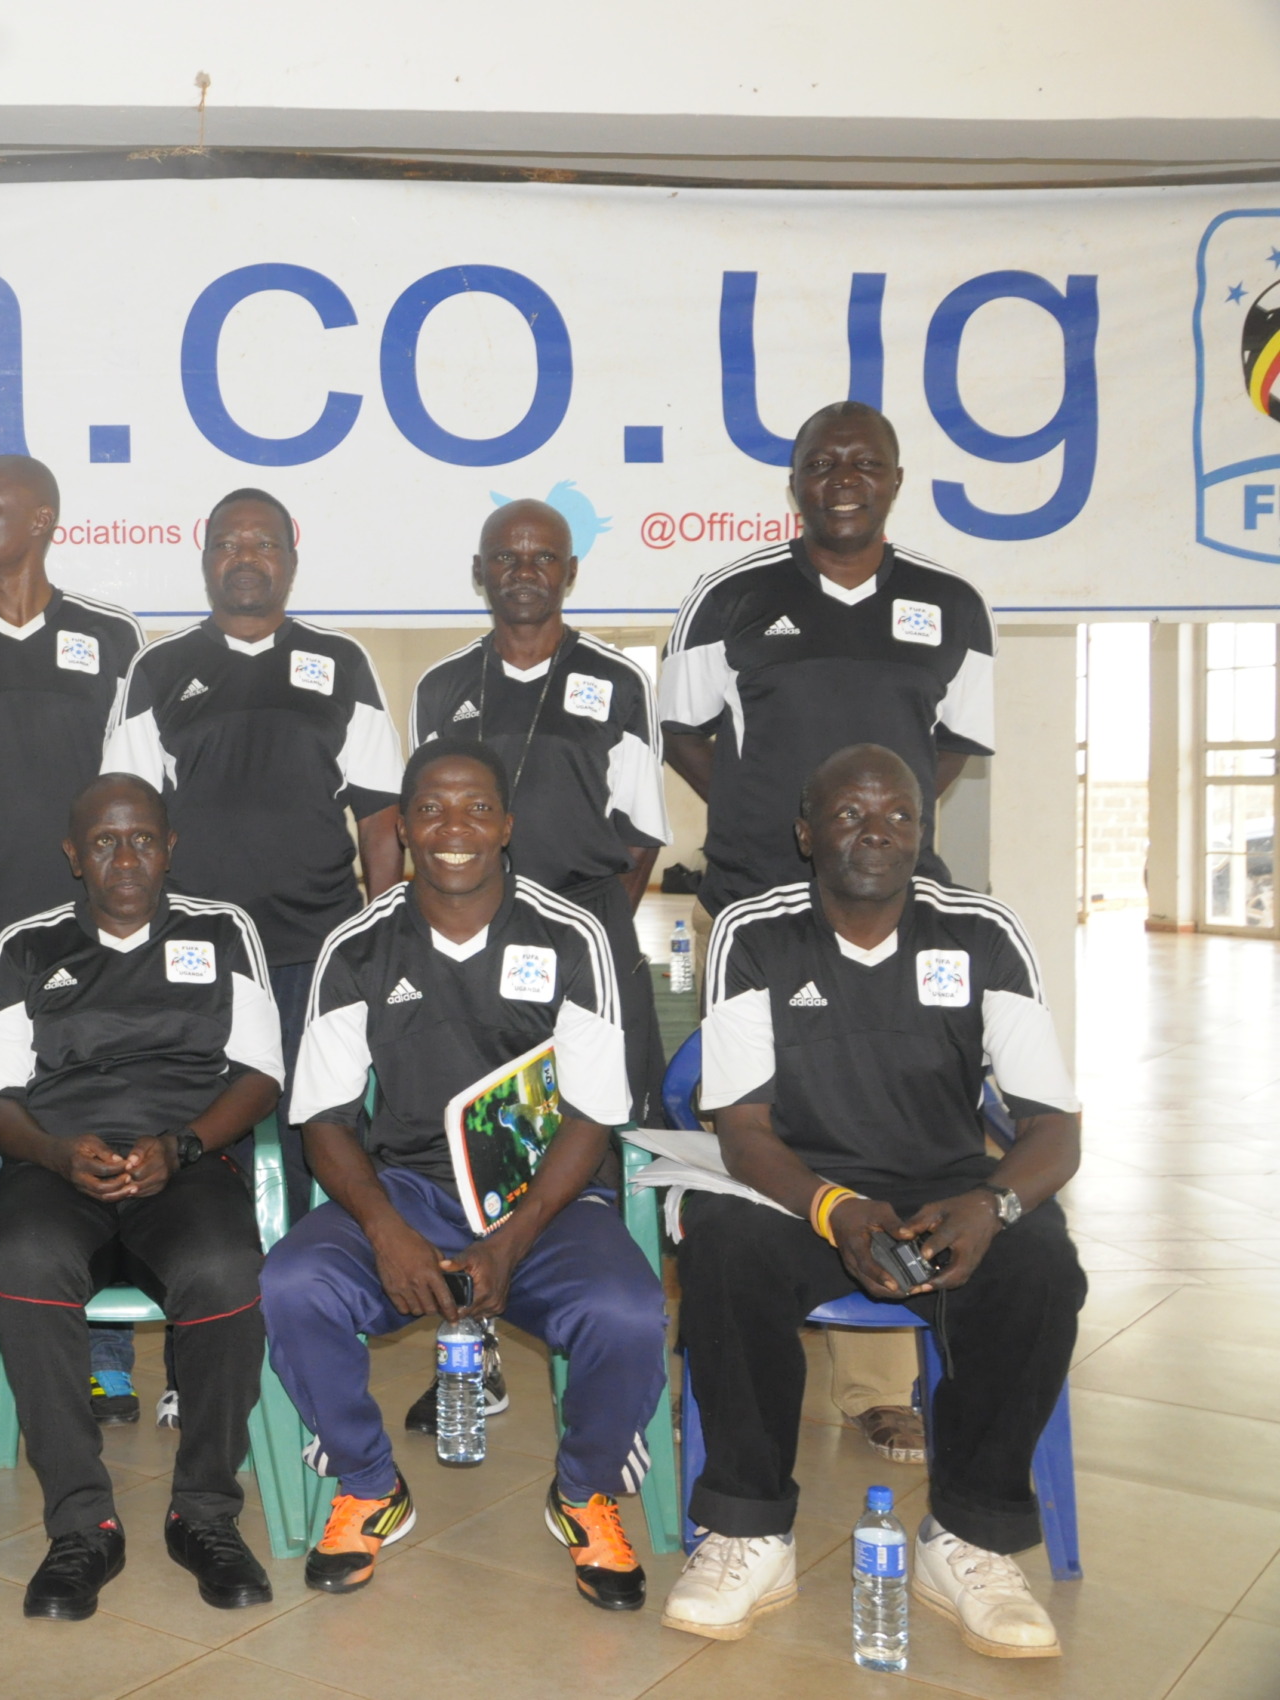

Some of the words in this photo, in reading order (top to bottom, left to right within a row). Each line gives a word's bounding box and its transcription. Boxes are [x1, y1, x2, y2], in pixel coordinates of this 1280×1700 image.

[44, 978, 77, 990] adidas
[387, 991, 422, 1004] adidas
[789, 998, 828, 1006] adidas
